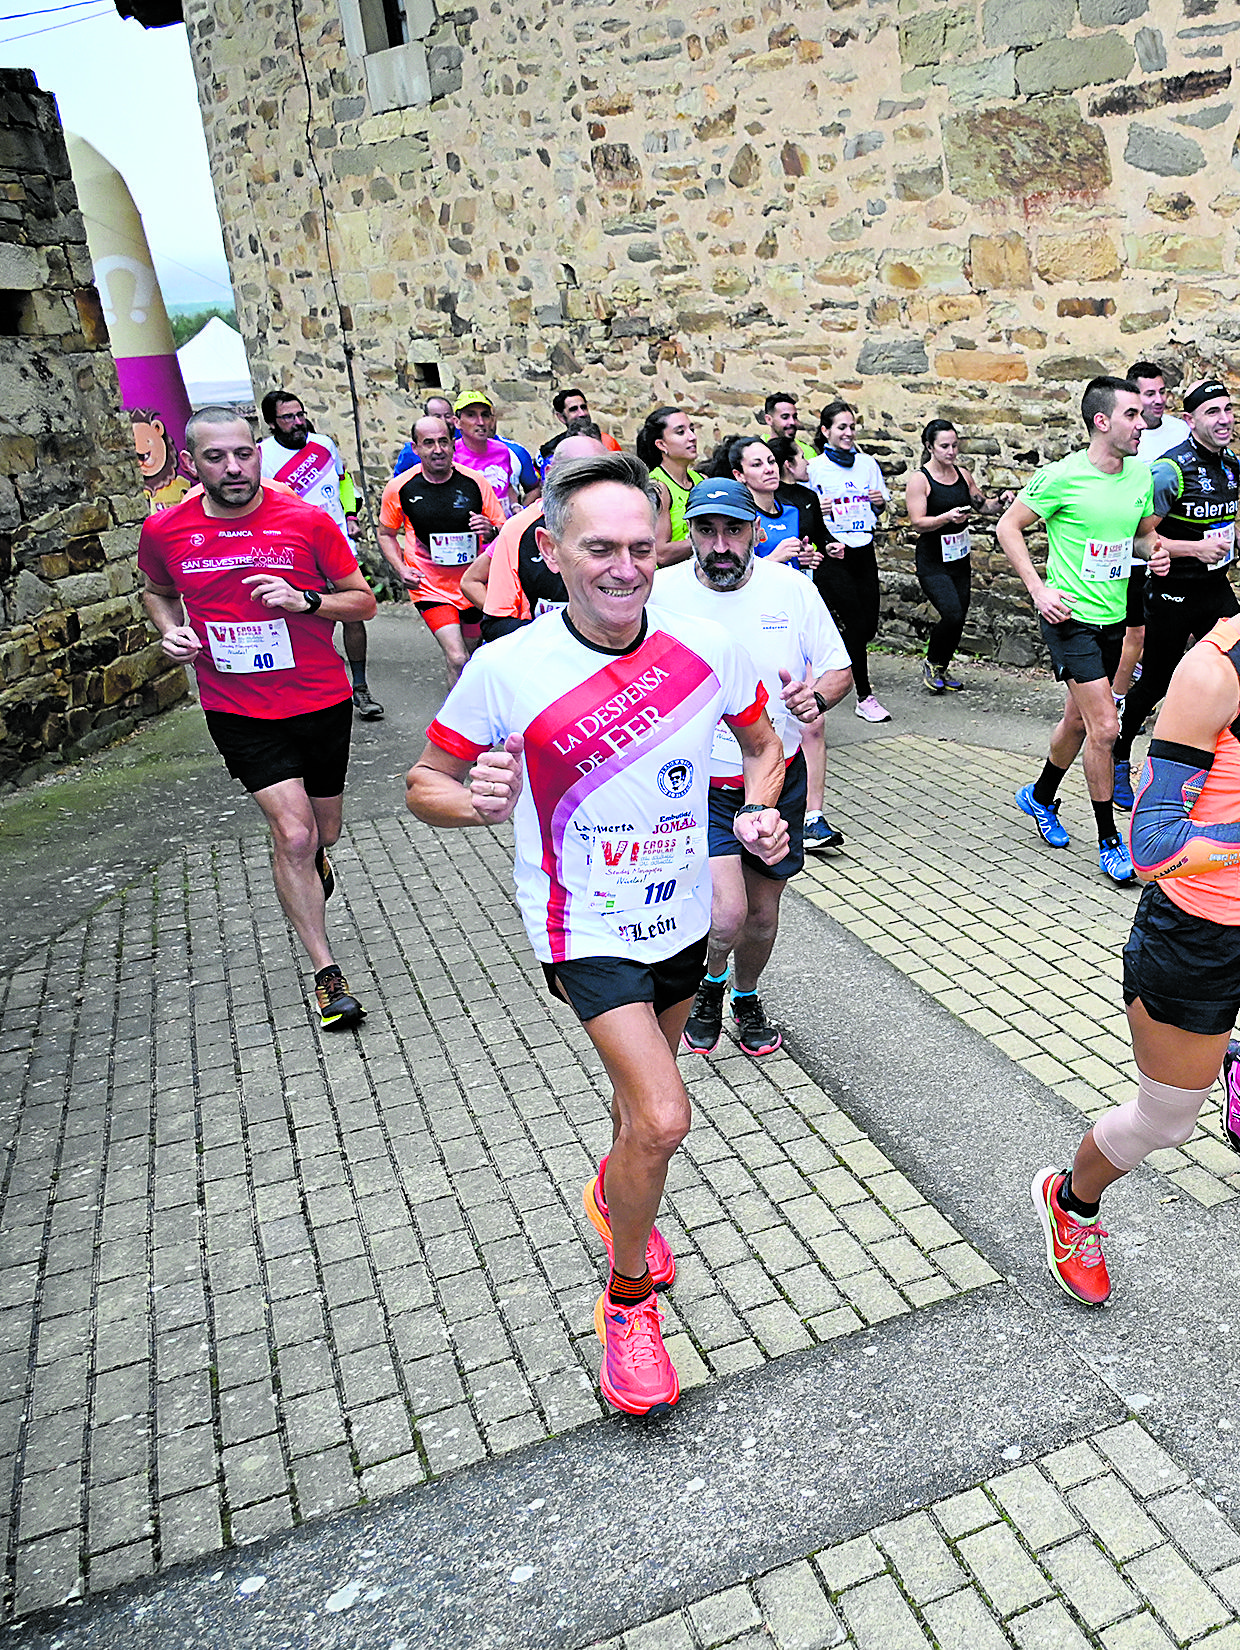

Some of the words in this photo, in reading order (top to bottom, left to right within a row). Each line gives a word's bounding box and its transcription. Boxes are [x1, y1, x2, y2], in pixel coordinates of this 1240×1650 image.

[218, 530, 253, 538] ABANCA
[852, 520, 865, 530] 123
[181, 560, 201, 571] SAN
[202, 556, 252, 568] SILVESTRE
[456, 552, 468, 564] 26
[1109, 564, 1122, 579] 94
[210, 625, 237, 644] VI
[236, 625, 262, 633] CROSS
[253, 652, 274, 670] 40
[552, 733, 583, 756] LA
[574, 665, 671, 740] DESPENSA
[574, 750, 609, 777] DE
[598, 705, 675, 761] FER
[601, 840, 640, 867] VI
[643, 838, 677, 850] CROSS
[642, 847, 674, 856] POPULAR
[644, 878, 677, 905] 110
[627, 914, 677, 942] León
